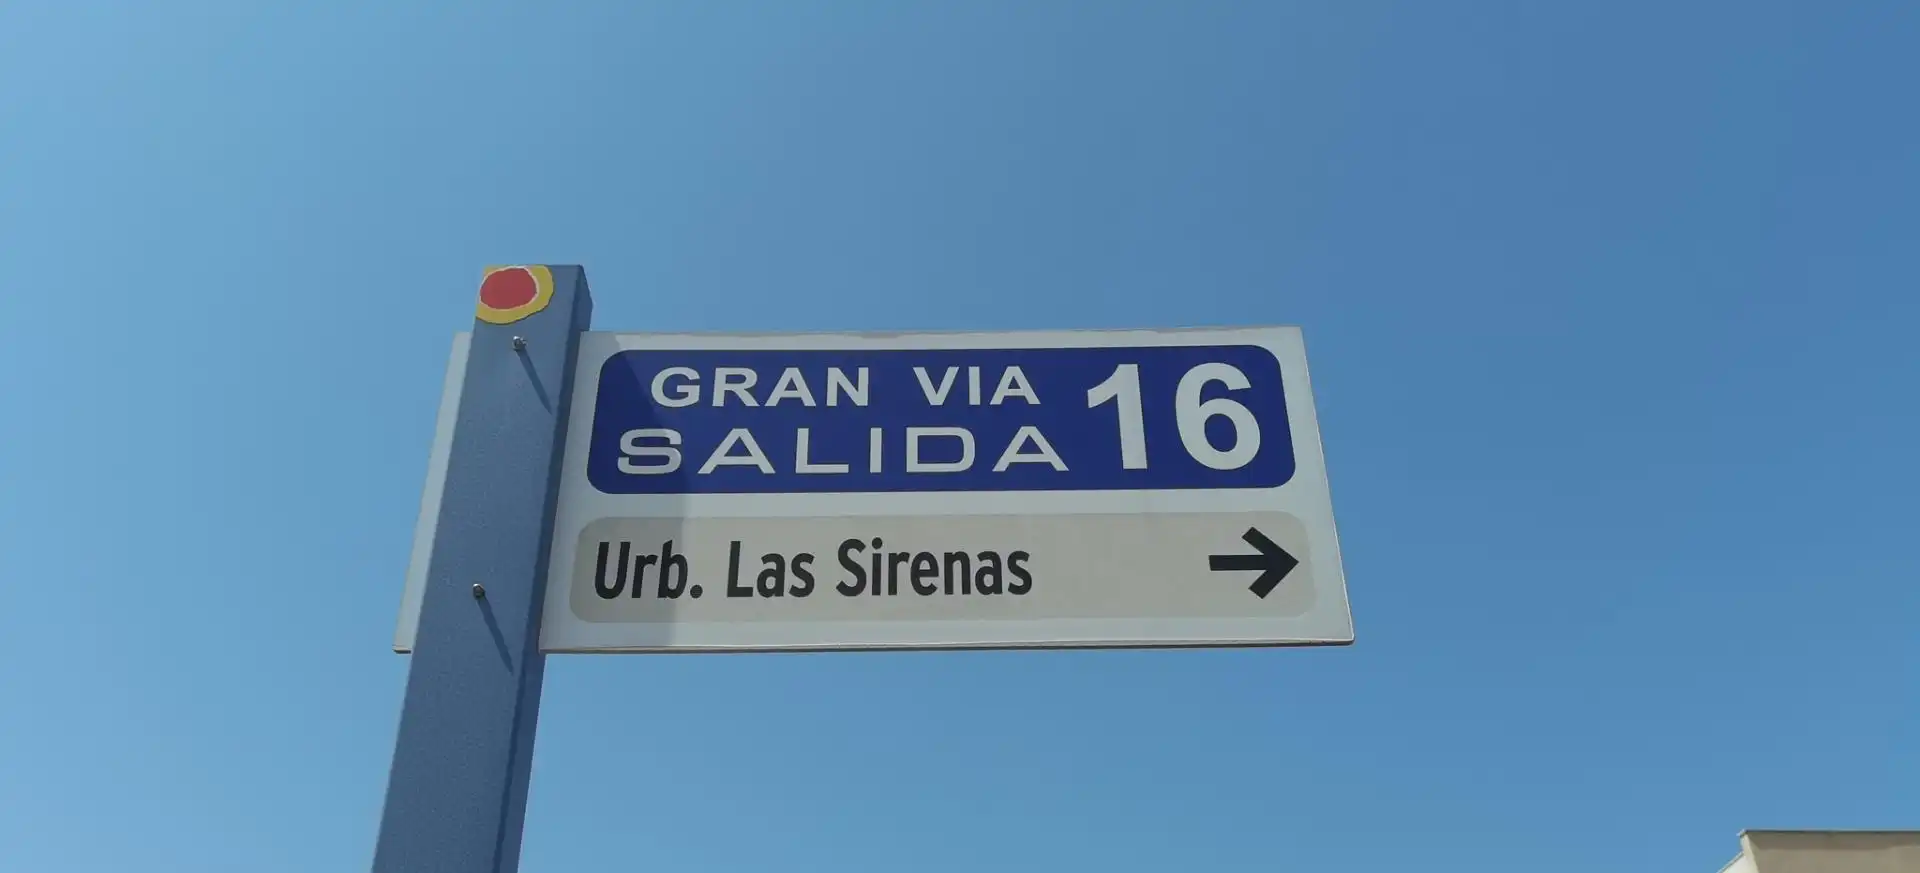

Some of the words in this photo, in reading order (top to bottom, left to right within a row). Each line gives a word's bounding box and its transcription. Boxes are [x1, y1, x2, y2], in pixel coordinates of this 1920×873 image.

[651, 366, 869, 408] GRAN
[912, 366, 1041, 406] VIA
[1087, 362, 1261, 470] 16
[616, 425, 1069, 475] SALIDA
[593, 539, 704, 600] Urb.
[726, 540, 815, 599] Las
[835, 537, 1033, 597] Sirenas
